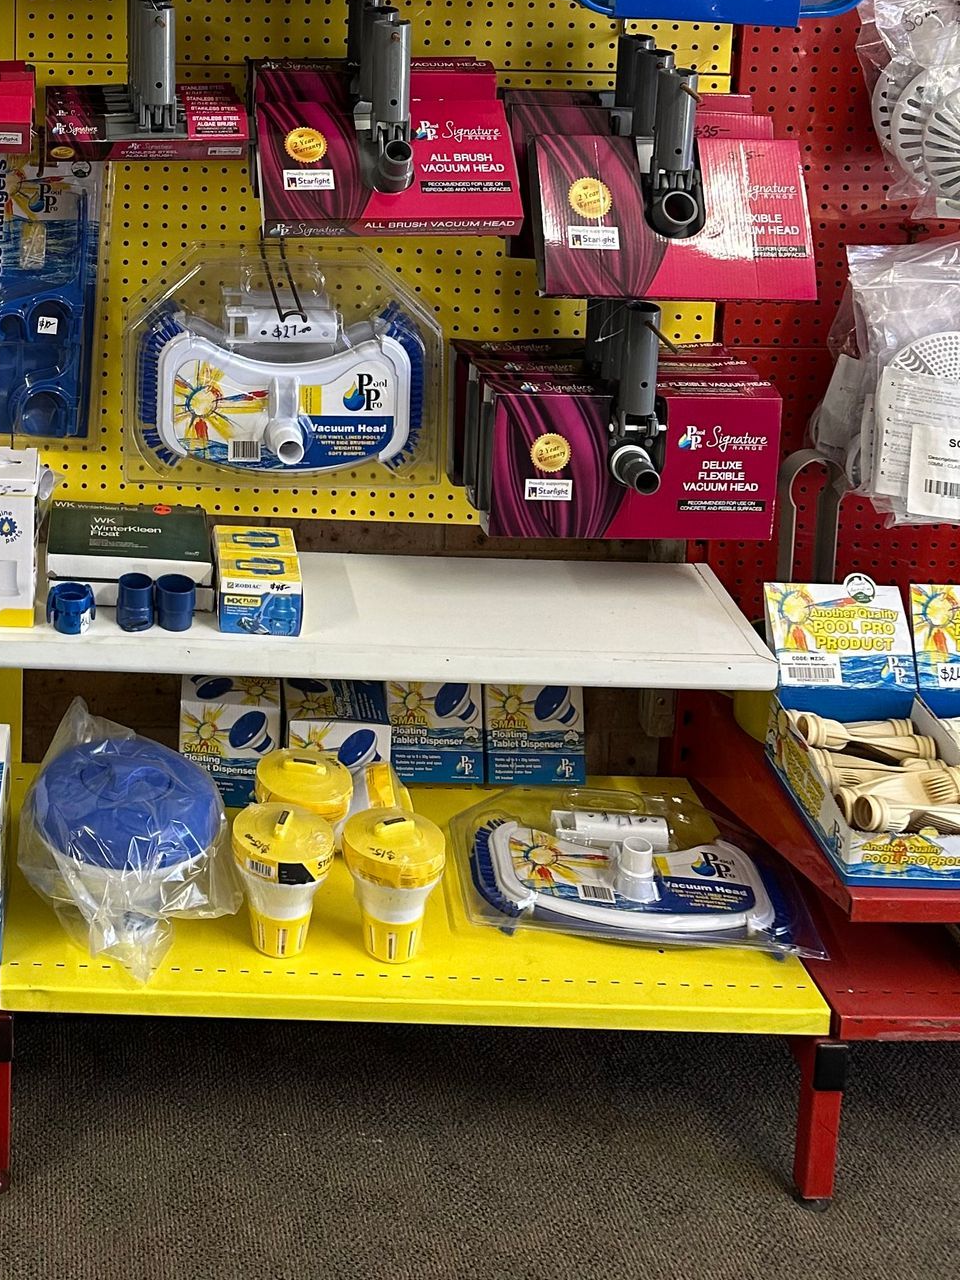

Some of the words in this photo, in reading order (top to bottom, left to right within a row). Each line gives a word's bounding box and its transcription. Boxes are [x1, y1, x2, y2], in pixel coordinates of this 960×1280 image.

[442, 121, 501, 142] Signature
[430, 154, 451, 162] ALL
[453, 154, 493, 162] BRUSH
[421, 164, 470, 172] VACUUM
[473, 164, 505, 172] HEAD
[767, 225, 800, 235] HEAD
[311, 424, 355, 433] Vacuum
[358, 424, 387, 433] Head
[702, 461, 742, 470] DELUXE
[698, 472, 745, 481] FLEXIBLE
[683, 482, 727, 492] VACUUM
[730, 482, 758, 492] HEAD
[90, 525, 162, 534] WinterKleen
[810, 608, 856, 620] Another
[858, 608, 898, 620] Quality
[813, 621, 857, 635] POOL
[862, 622, 895, 635] PRO
[816, 637, 895, 651] PRODUCT
[391, 716, 427, 726] SMALL
[492, 720, 527, 729] SMALL
[392, 726, 428, 738] Floating
[492, 730, 528, 740] Floating
[392, 736, 419, 747] Tablet
[421, 736, 463, 748] Dispenser
[492, 739, 519, 748] Tablet
[520, 740, 564, 750] Dispenser
[183, 744, 220, 754] SMALL
[185, 754, 220, 765] Floating
[862, 842, 906, 854] Another
[909, 844, 943, 854] Quality
[862, 854, 898, 865] POOL
[900, 855, 926, 866] PRO
